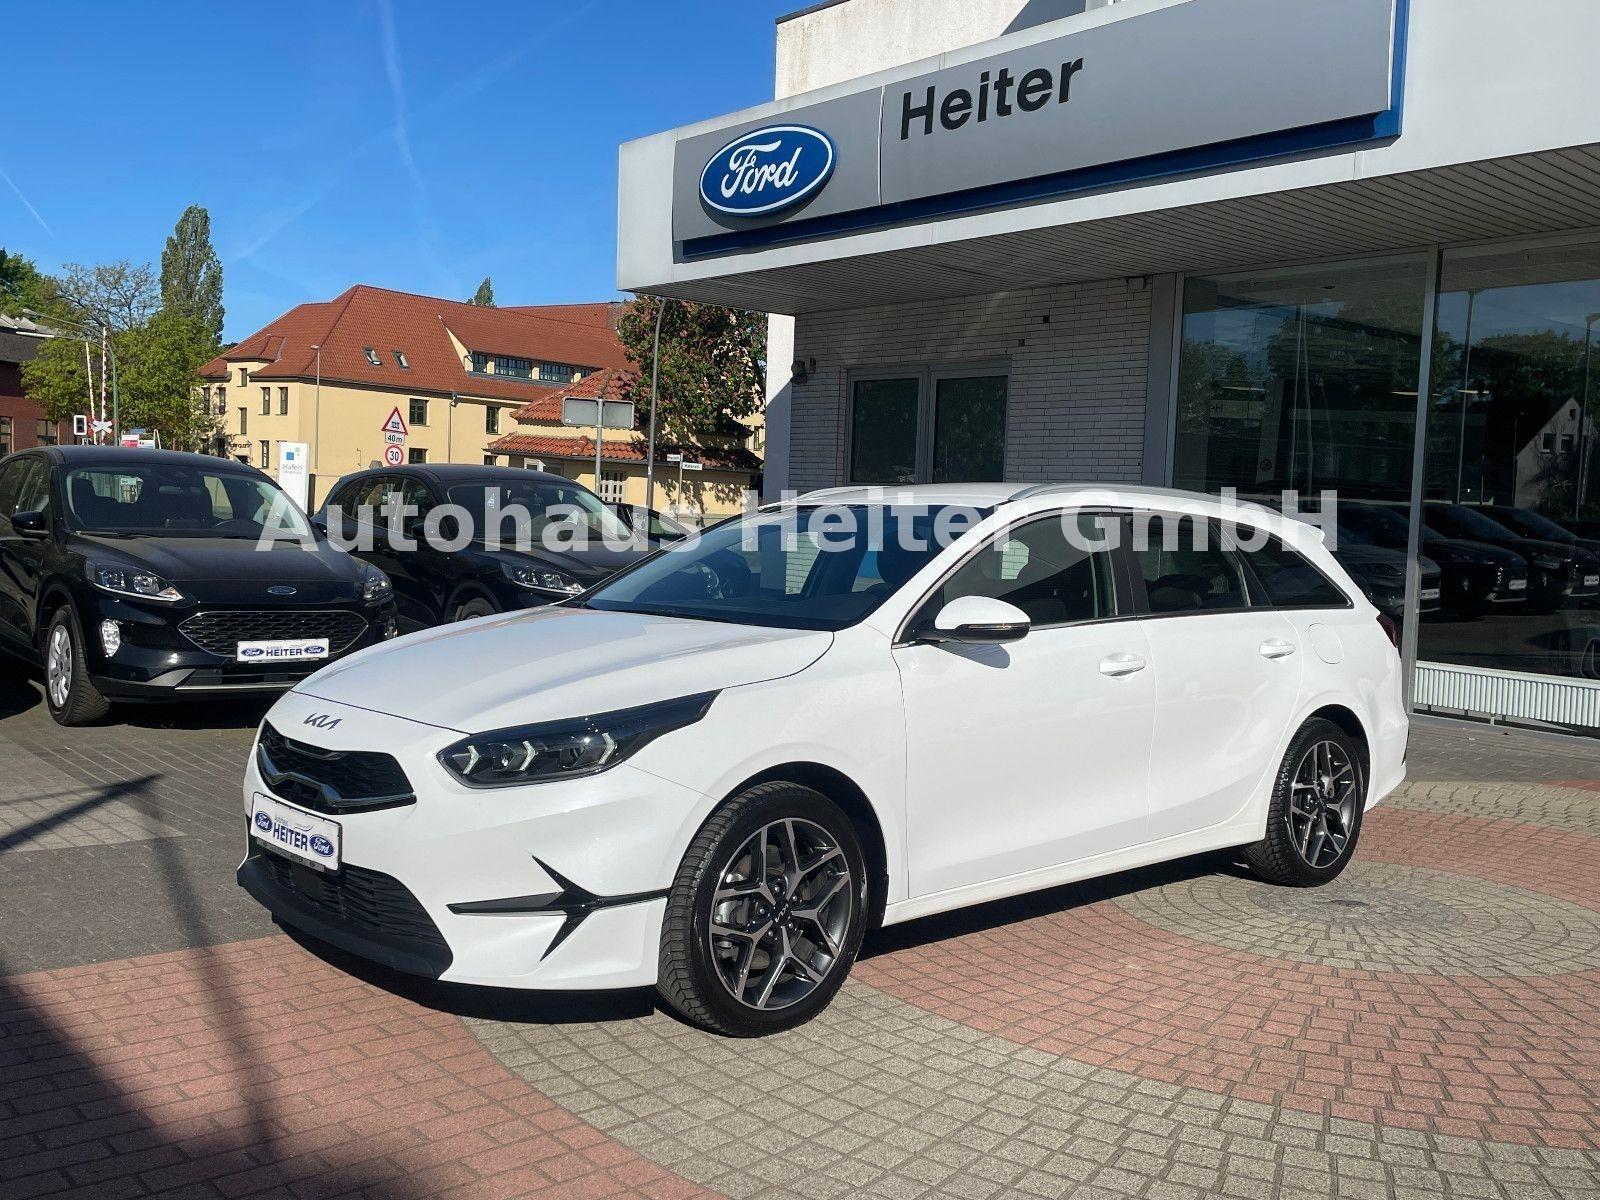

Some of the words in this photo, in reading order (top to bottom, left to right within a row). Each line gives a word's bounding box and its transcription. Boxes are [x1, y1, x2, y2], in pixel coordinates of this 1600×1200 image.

[900, 57, 1083, 140] Heiter
[720, 139, 803, 198] Ford
[389, 450, 400, 462] 30
[266, 648, 303, 657] HEITER
[303, 712, 343, 730] KIA
[273, 822, 308, 851] HEITER
